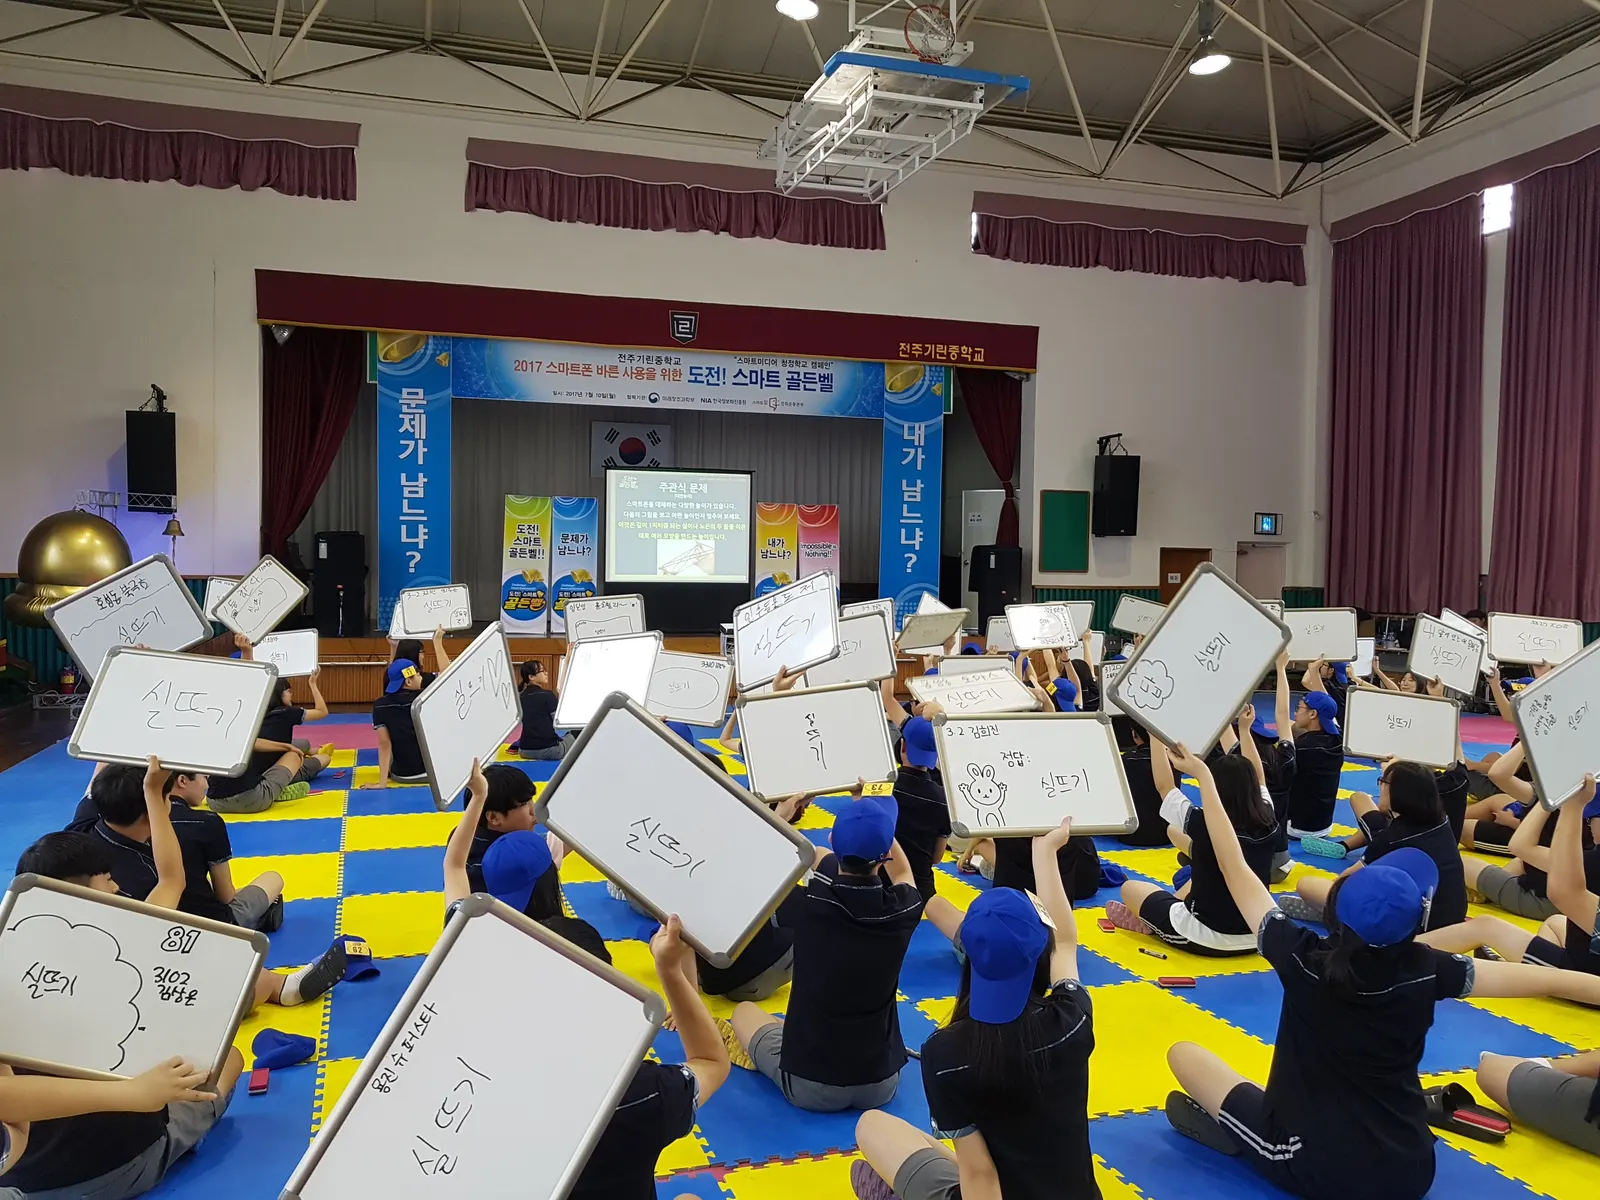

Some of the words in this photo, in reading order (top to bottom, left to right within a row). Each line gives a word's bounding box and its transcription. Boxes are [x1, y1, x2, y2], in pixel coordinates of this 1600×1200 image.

[617, 353, 682, 366] 전주기린중학교
[899, 342, 985, 362] 전주기린중학교
[514, 359, 543, 373] 2017
[545, 361, 594, 377] 스마트폰
[596, 364, 620, 379] 바른
[622, 366, 657, 381] 사용을
[660, 368, 683, 382] 위한
[687, 365, 727, 387] 도전!
[731, 368, 781, 389] 스마트
[785, 371, 834, 393] 골든벨
[398, 387, 428, 465] 문제가
[901, 423, 926, 471] 내가
[659, 481, 687, 494] 주관식
[689, 482, 709, 494] 문제
[399, 472, 429, 573] 남느냐?
[516, 524, 539, 536] 도전!
[899, 479, 925, 573] 남느냐?
[513, 535, 542, 547] 스마트
[560, 533, 589, 544] 문제가
[767, 537, 785, 548] 내가
[800, 542, 832, 551] Impossible
[508, 547, 545, 560] 골든벨!!
[557, 546, 592, 557] 남느냐?
[760, 549, 792, 560] 남느냐?
[423, 598, 452, 614] 실뜨기
[504, 597, 546, 611] 골든벨
[117, 605, 167, 645] 실뜨기
[753, 612, 816, 659] 실뜨기
[1517, 631, 1561, 653] 실뜨기
[838, 639, 862, 659] 뜨기
[1194, 631, 1231, 672] 실뜨기
[1430, 645, 1468, 670] 실뜨기
[947, 687, 1003, 709] 실뜨기
[142, 680, 242, 740] 실뜨기
[968, 724, 1000, 739] 김희진
[1387, 714, 1412, 729] 실뜨기
[1000, 751, 1031, 768] 정답:
[871, 783, 883, 791] 73
[1041, 768, 1090, 798] 실뜨기
[625, 816, 706, 878] 실뜨기
[160, 925, 201, 955] 81
[352, 946, 363, 954] 62
[21, 962, 78, 999] 실뜨기
[412, 1056, 492, 1176] 실뜨기
